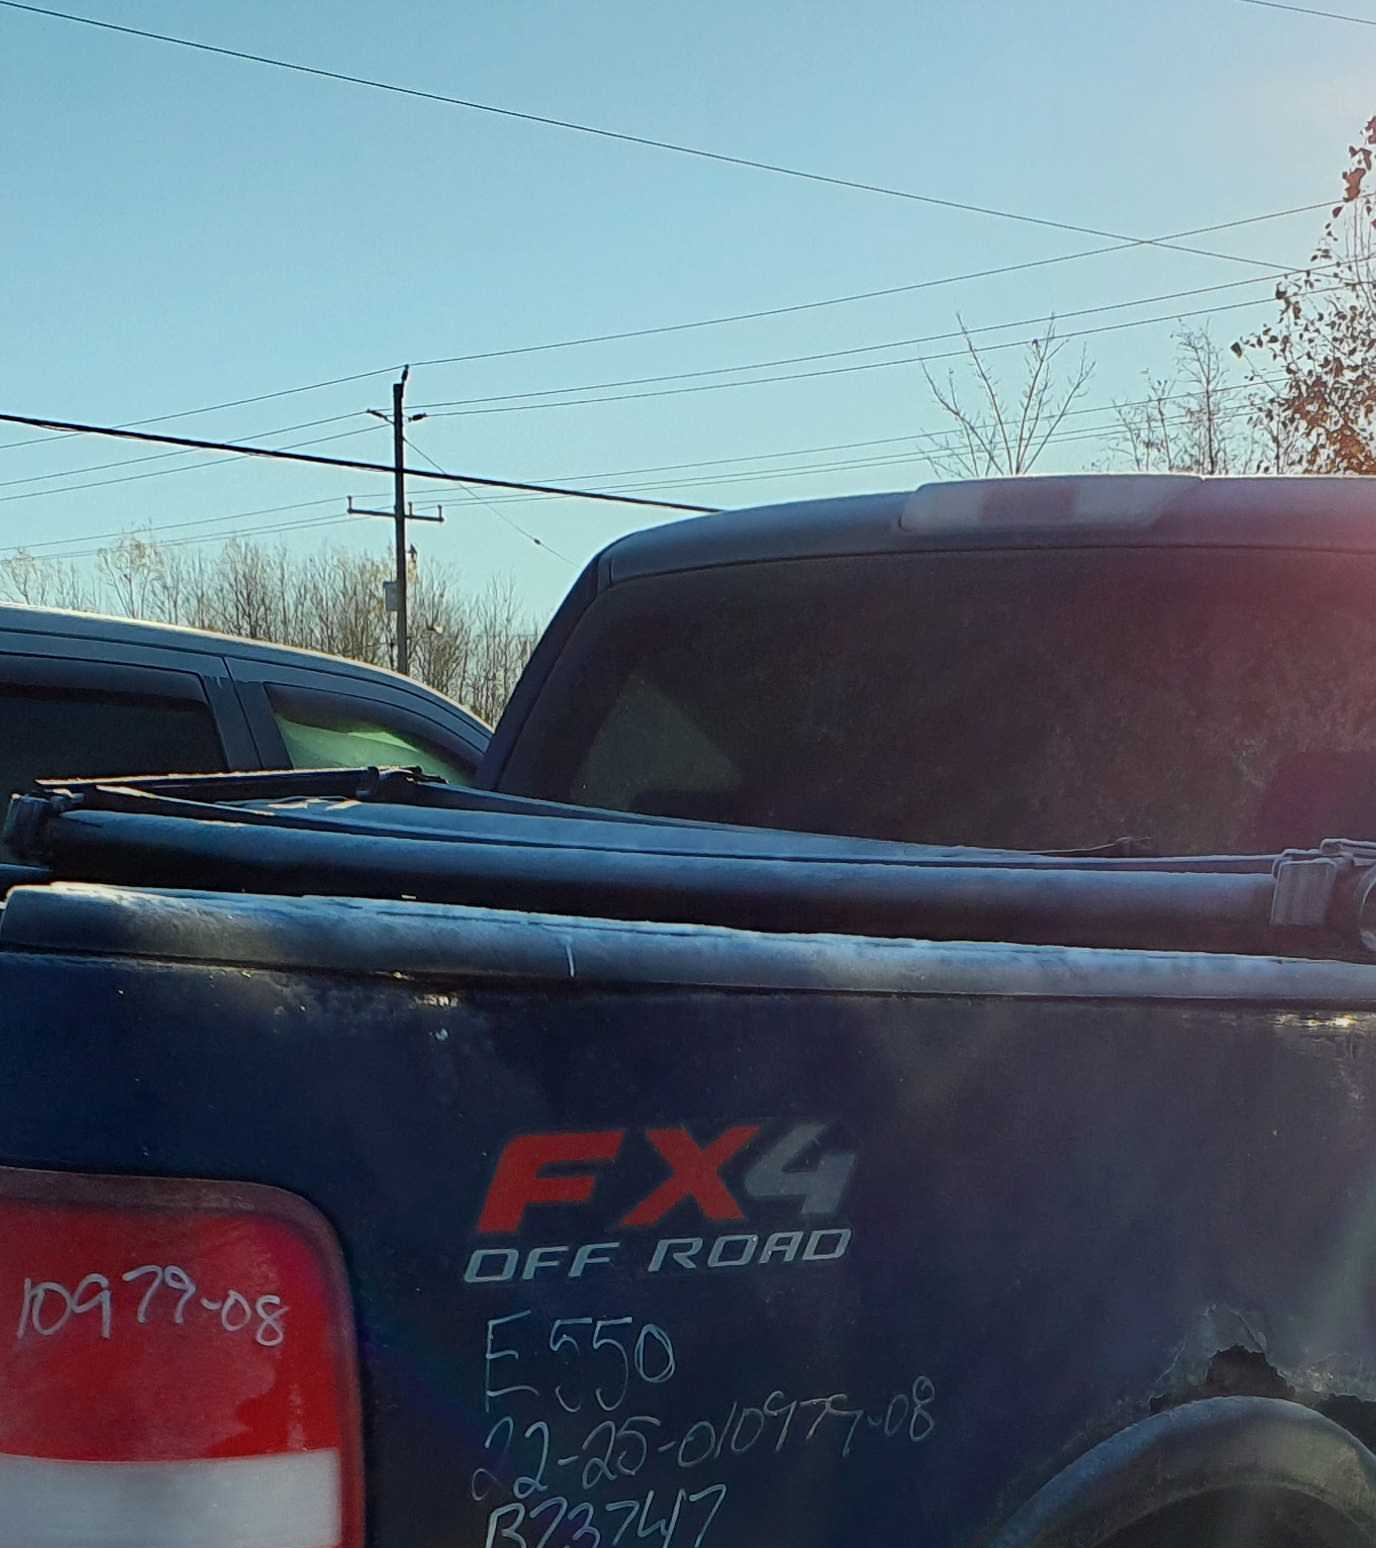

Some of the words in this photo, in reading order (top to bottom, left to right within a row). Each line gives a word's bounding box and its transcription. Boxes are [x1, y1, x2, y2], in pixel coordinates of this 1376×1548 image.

[476, 1121, 856, 1234] FX4
[464, 1241, 620, 1283] OFF
[648, 1228, 853, 1272] ROAD
[16, 1264, 288, 1347] 10979-08
[472, 1375, 936, 1500] 22-25-010979-08
